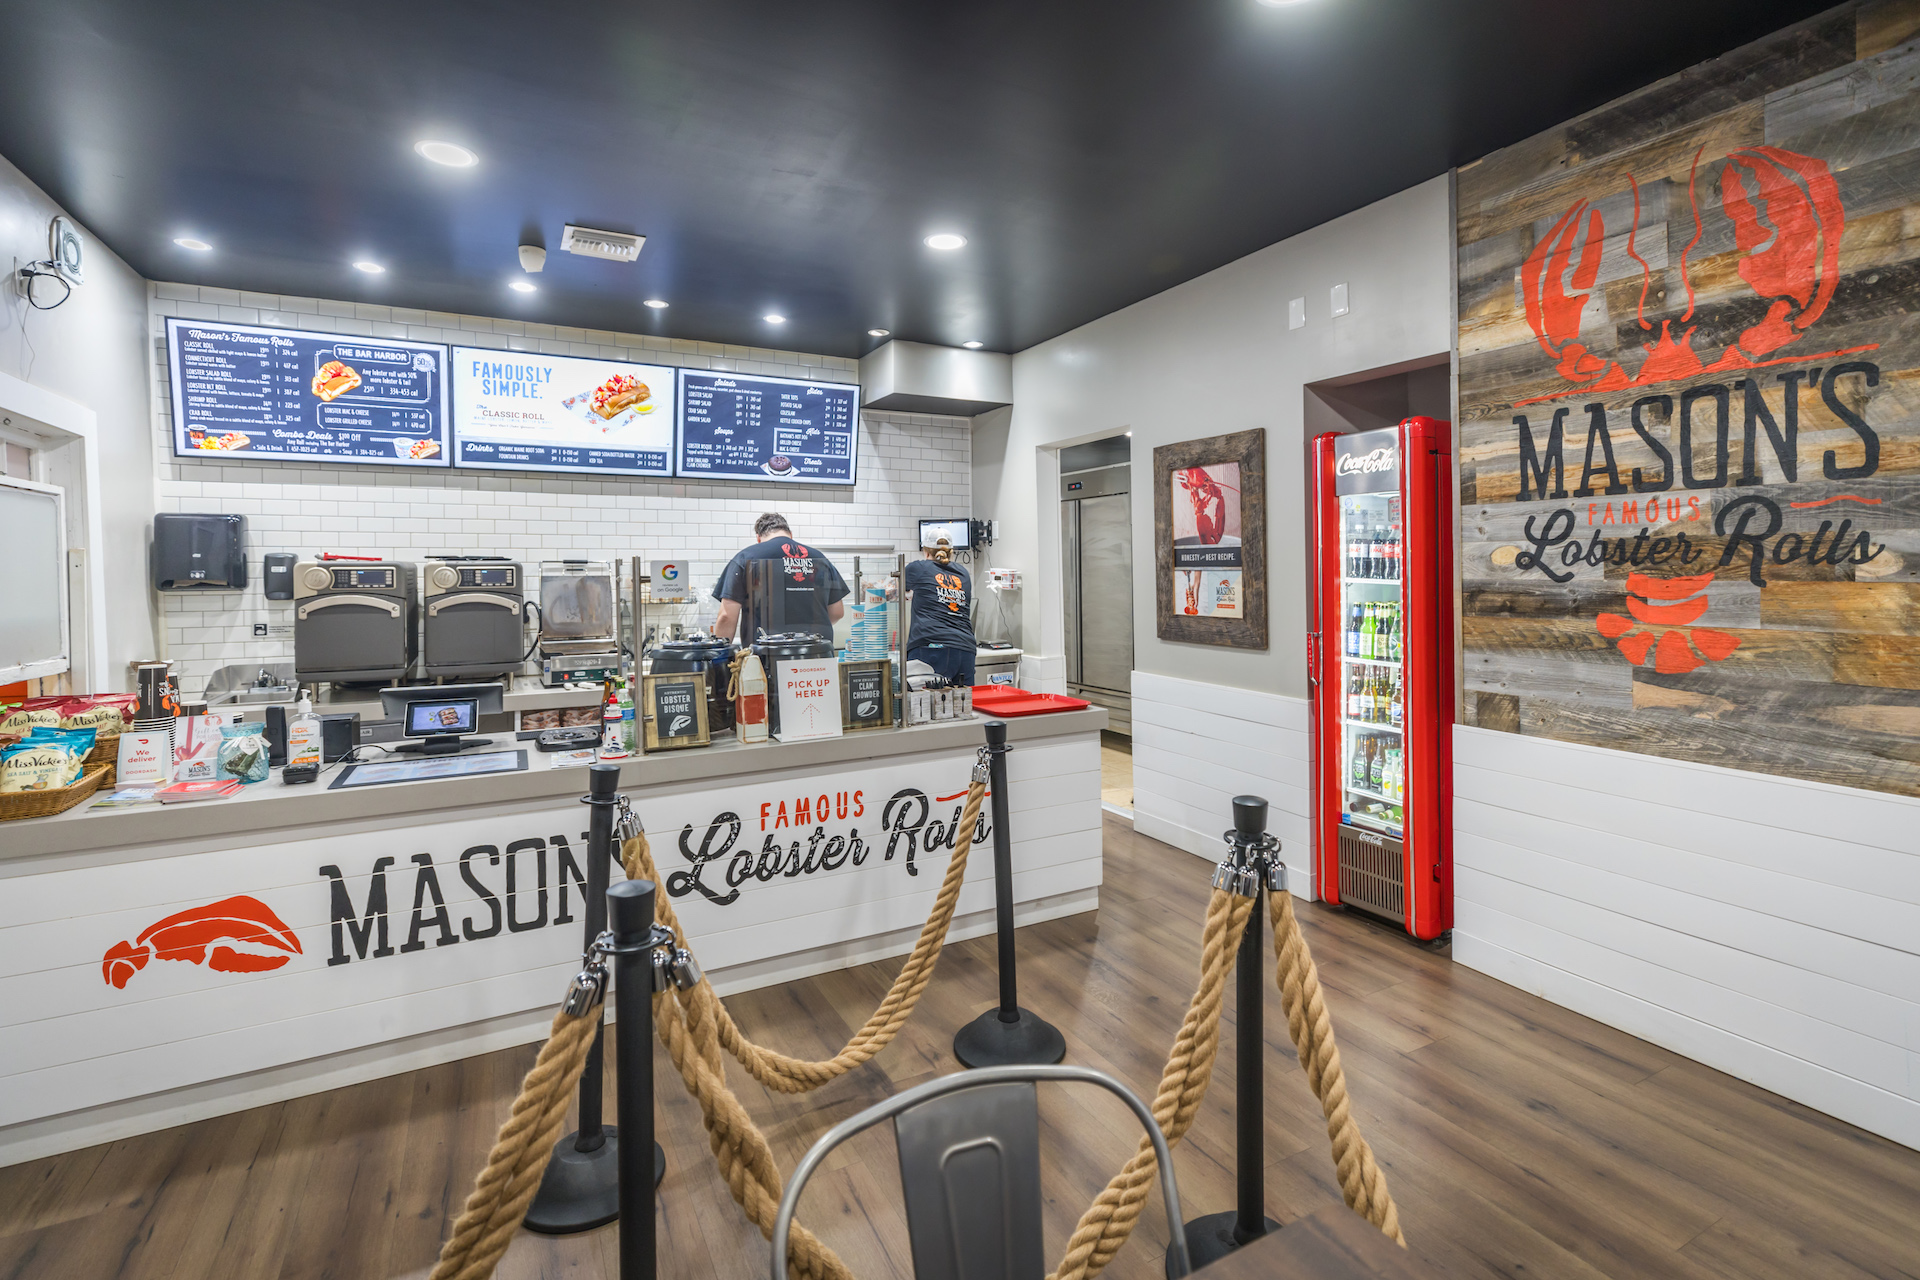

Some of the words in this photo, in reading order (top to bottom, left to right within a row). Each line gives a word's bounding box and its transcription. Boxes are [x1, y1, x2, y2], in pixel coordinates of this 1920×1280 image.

[188, 330, 230, 341] Mason's
[231, 333, 270, 344] Famous
[270, 336, 294, 347] Rolls
[185, 354, 215, 363] CONNECTICUT
[337, 348, 353, 356] THE
[355, 349, 372, 358] BAR
[374, 350, 406, 361] HARBOR
[473, 361, 552, 383] FAMOUSLY
[714, 378, 736, 387] Salads
[483, 379, 542, 399] SIMPLE.
[806, 386, 823, 395] Sides
[483, 410, 520, 418] CLASSIC
[272, 429, 305, 439] Combo
[306, 430, 333, 440] Deals
[351, 433, 361, 441] Off
[714, 427, 734, 435] Soups
[806, 428, 821, 436] Kids
[1512, 361, 1881, 501] MASON'S
[466, 443, 494, 452] Drinks
[1336, 448, 1394, 477] Coca-Cola
[1588, 496, 1701, 526] FAMOUS
[1516, 508, 1702, 584] Lobster
[1714, 496, 1886, 588] Rolls
[782, 557, 813, 567] MASON'S
[936, 587, 966, 600] MASON'S
[1216, 587, 1235, 595] MASON'S
[787, 681, 813, 689] PICK
[816, 679, 830, 687] UP
[796, 689, 824, 698] HERE
[853, 690, 880, 699] CHOWDER
[661, 695, 691, 704] LOBSTER
[664, 704, 689, 713] BISQUE
[5, 717, 26, 728] Miss
[26, 714, 58, 724] Vickie's
[72, 716, 94, 727] Miss
[3, 760, 31, 770] Miss
[31, 754, 67, 767] Vickie's
[760, 790, 865, 832] FAMOUS
[666, 811, 870, 906] Lobster
[882, 788, 992, 876] Rols
[320, 831, 623, 966] MASON
